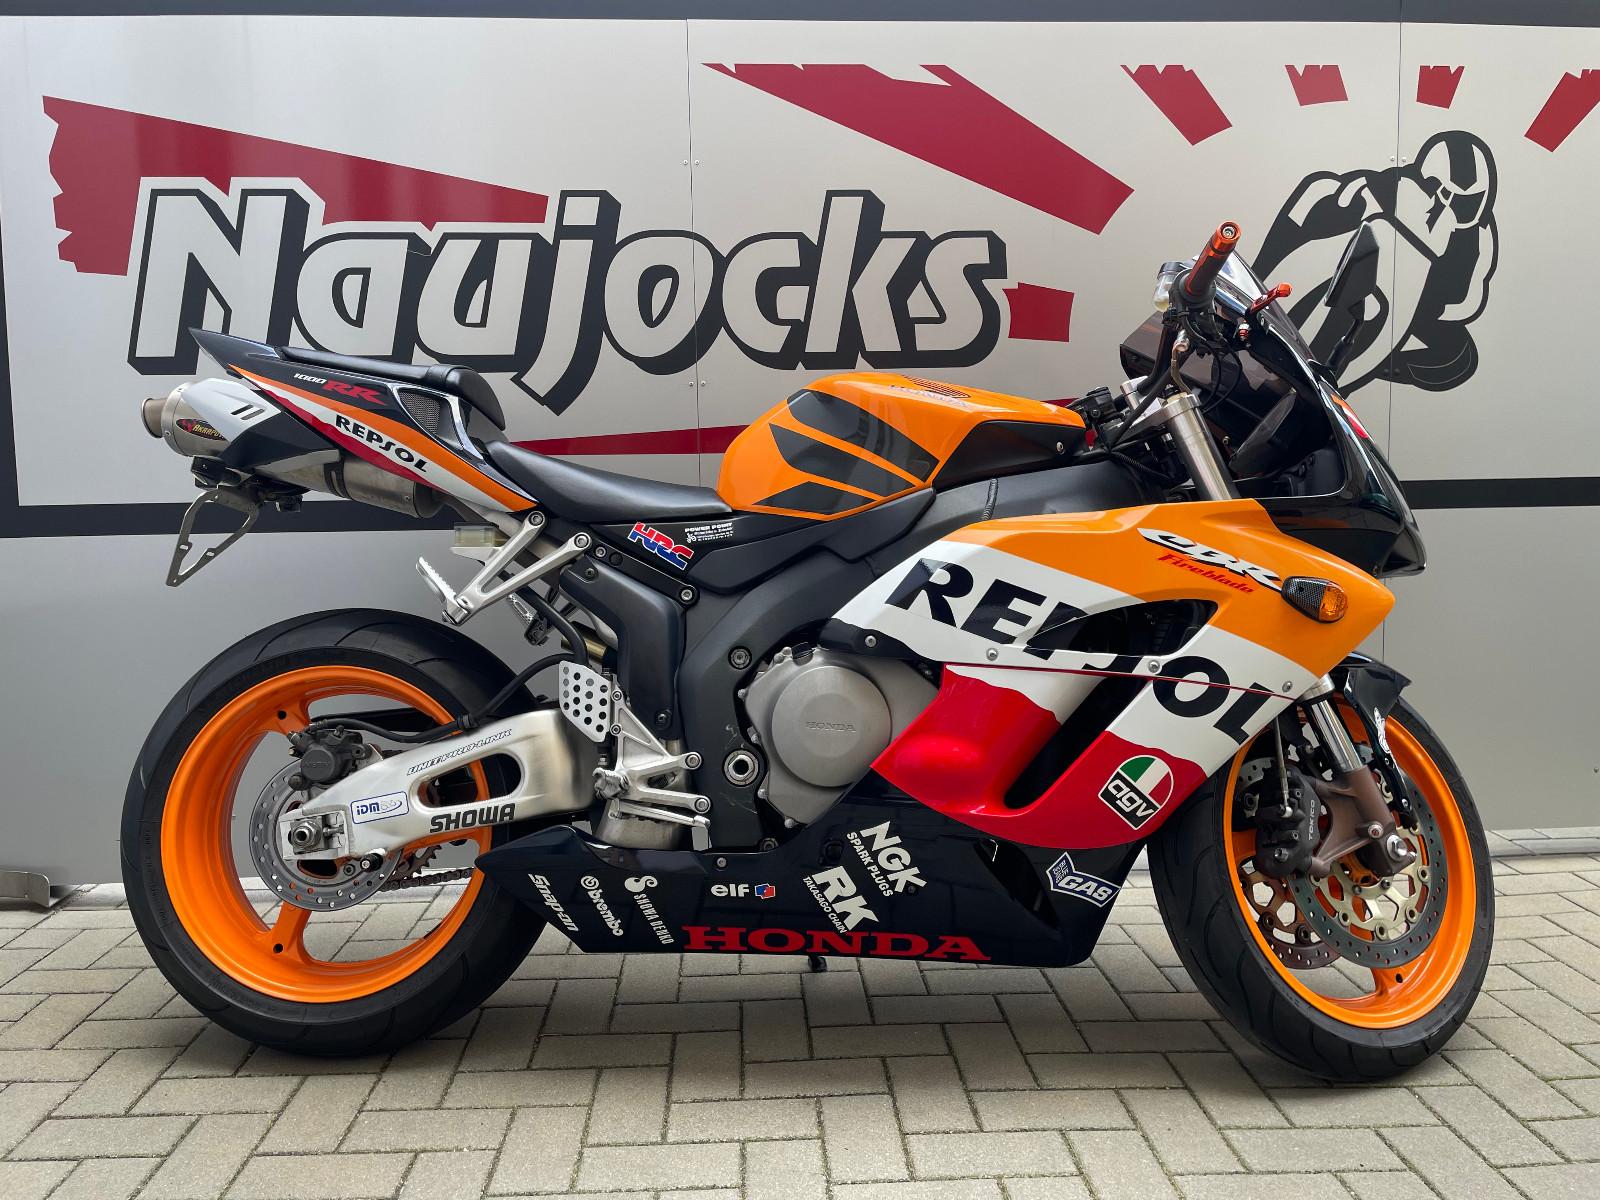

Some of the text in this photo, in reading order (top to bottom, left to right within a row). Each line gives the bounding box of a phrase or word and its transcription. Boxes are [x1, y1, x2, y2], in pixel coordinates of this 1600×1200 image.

[128, 189, 1007, 415] Naujocks
[336, 414, 428, 473] REPSOL
[628, 521, 695, 571] HRC
[1136, 527, 1282, 592] CBR
[1158, 554, 1254, 594] Fireblade
[805, 721, 857, 733] HONDA
[430, 803, 516, 833] SHOWA
[1107, 779, 1155, 817] agv
[847, 831, 894, 897] SPARK PLUGS
[859, 820, 928, 893] NGK
[587, 888, 624, 937] brembo
[710, 883, 751, 898] elf
[803, 876, 848, 935] TAKASAGO CHAIN
[811, 865, 880, 931] RK
[1058, 875, 1113, 901] GAS
[633, 893, 675, 945] SHOWA DENKO
[680, 925, 992, 961] HONDA
